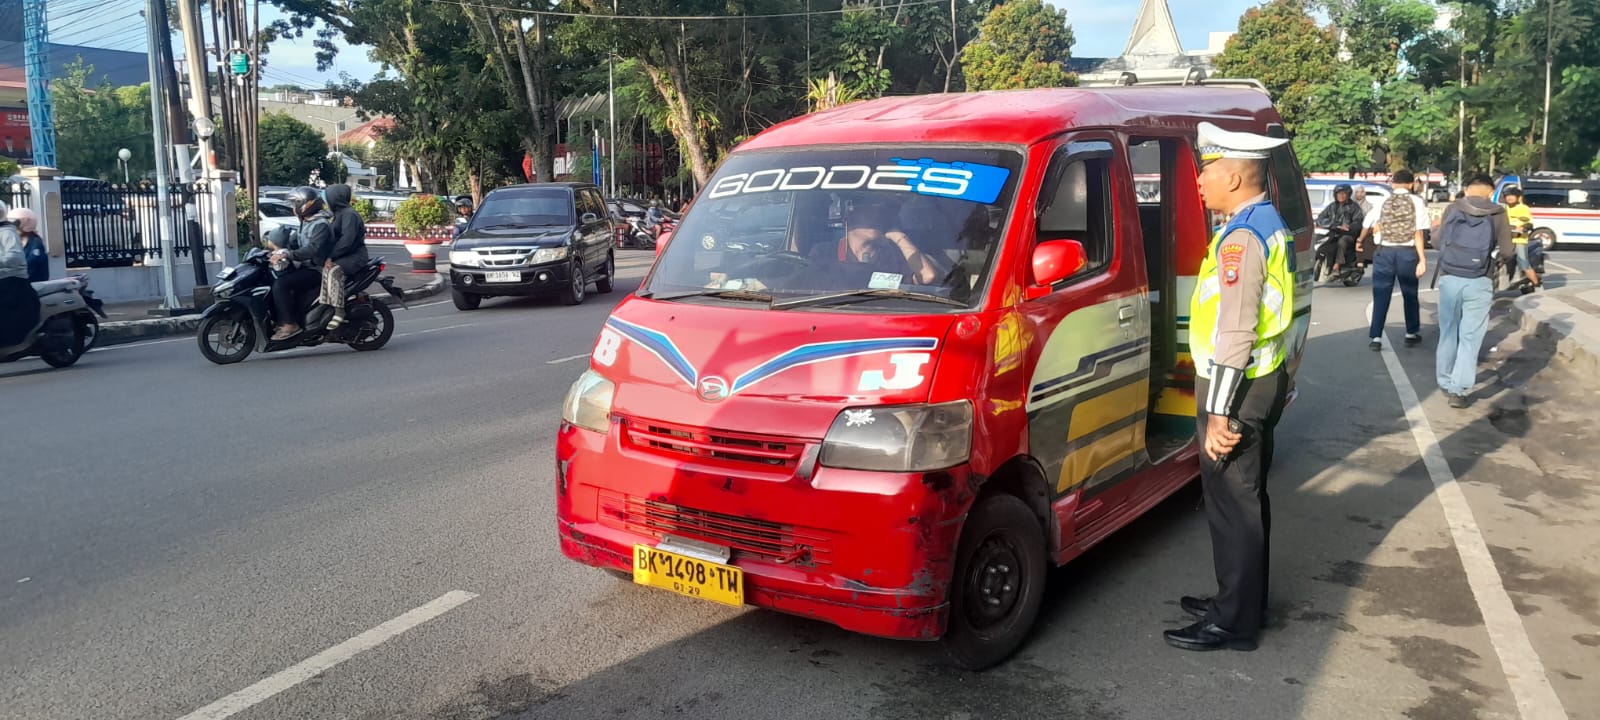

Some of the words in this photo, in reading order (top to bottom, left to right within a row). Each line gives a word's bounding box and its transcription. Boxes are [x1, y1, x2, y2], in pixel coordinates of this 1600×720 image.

[708, 165, 973, 199] GODDES
[593, 330, 620, 366] B
[857, 352, 930, 392] J
[638, 548, 658, 574] BK
[665, 554, 706, 585] 1498
[715, 566, 738, 593] TW
